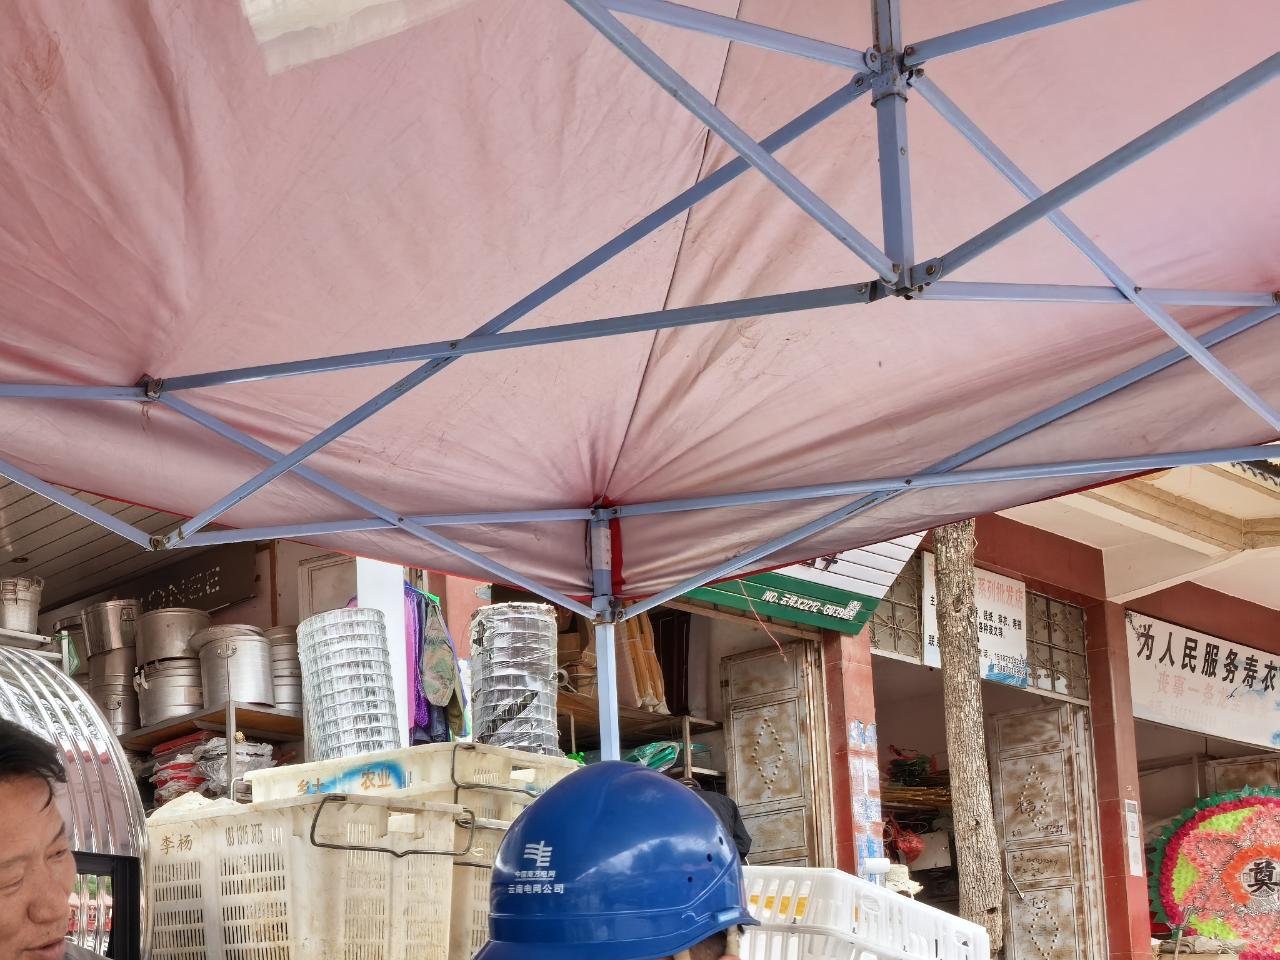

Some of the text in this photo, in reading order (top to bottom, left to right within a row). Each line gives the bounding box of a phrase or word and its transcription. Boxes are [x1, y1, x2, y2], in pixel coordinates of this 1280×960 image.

[1137, 624, 1278, 692] 为人民服务寿衣
[507, 884, 564, 894] 云南电网公司
[1247, 860, 1280, 894] 奠
